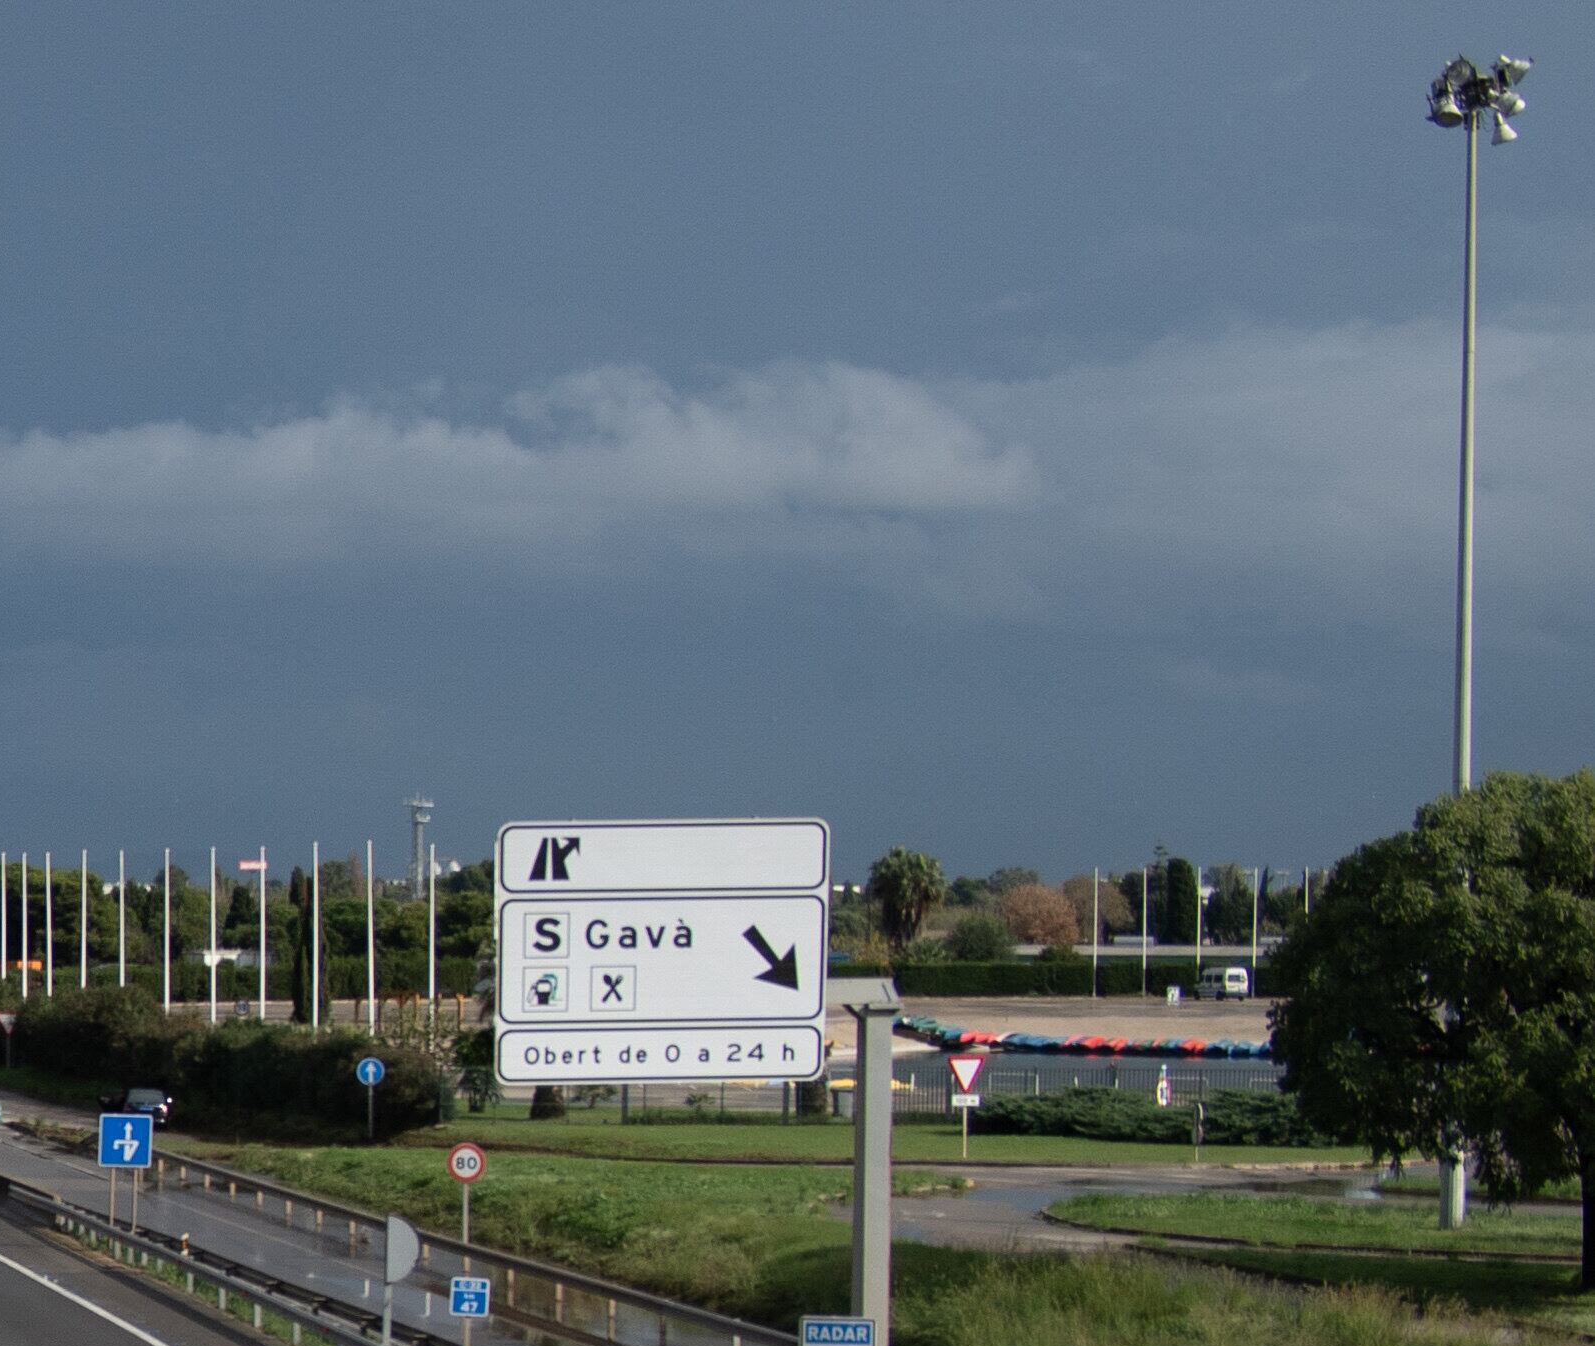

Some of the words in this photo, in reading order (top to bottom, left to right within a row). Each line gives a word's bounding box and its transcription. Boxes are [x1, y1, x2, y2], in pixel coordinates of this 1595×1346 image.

[533, 918, 561, 952] S
[585, 918, 693, 950] Gavà
[524, 1046, 601, 1065] Obert
[619, 1045, 648, 1064] de
[698, 1047, 710, 1063] a
[727, 1043, 764, 1062] 24
[782, 1043, 795, 1061] h
[456, 1157, 478, 1170] 80
[807, 1325, 869, 1343] RADAR
